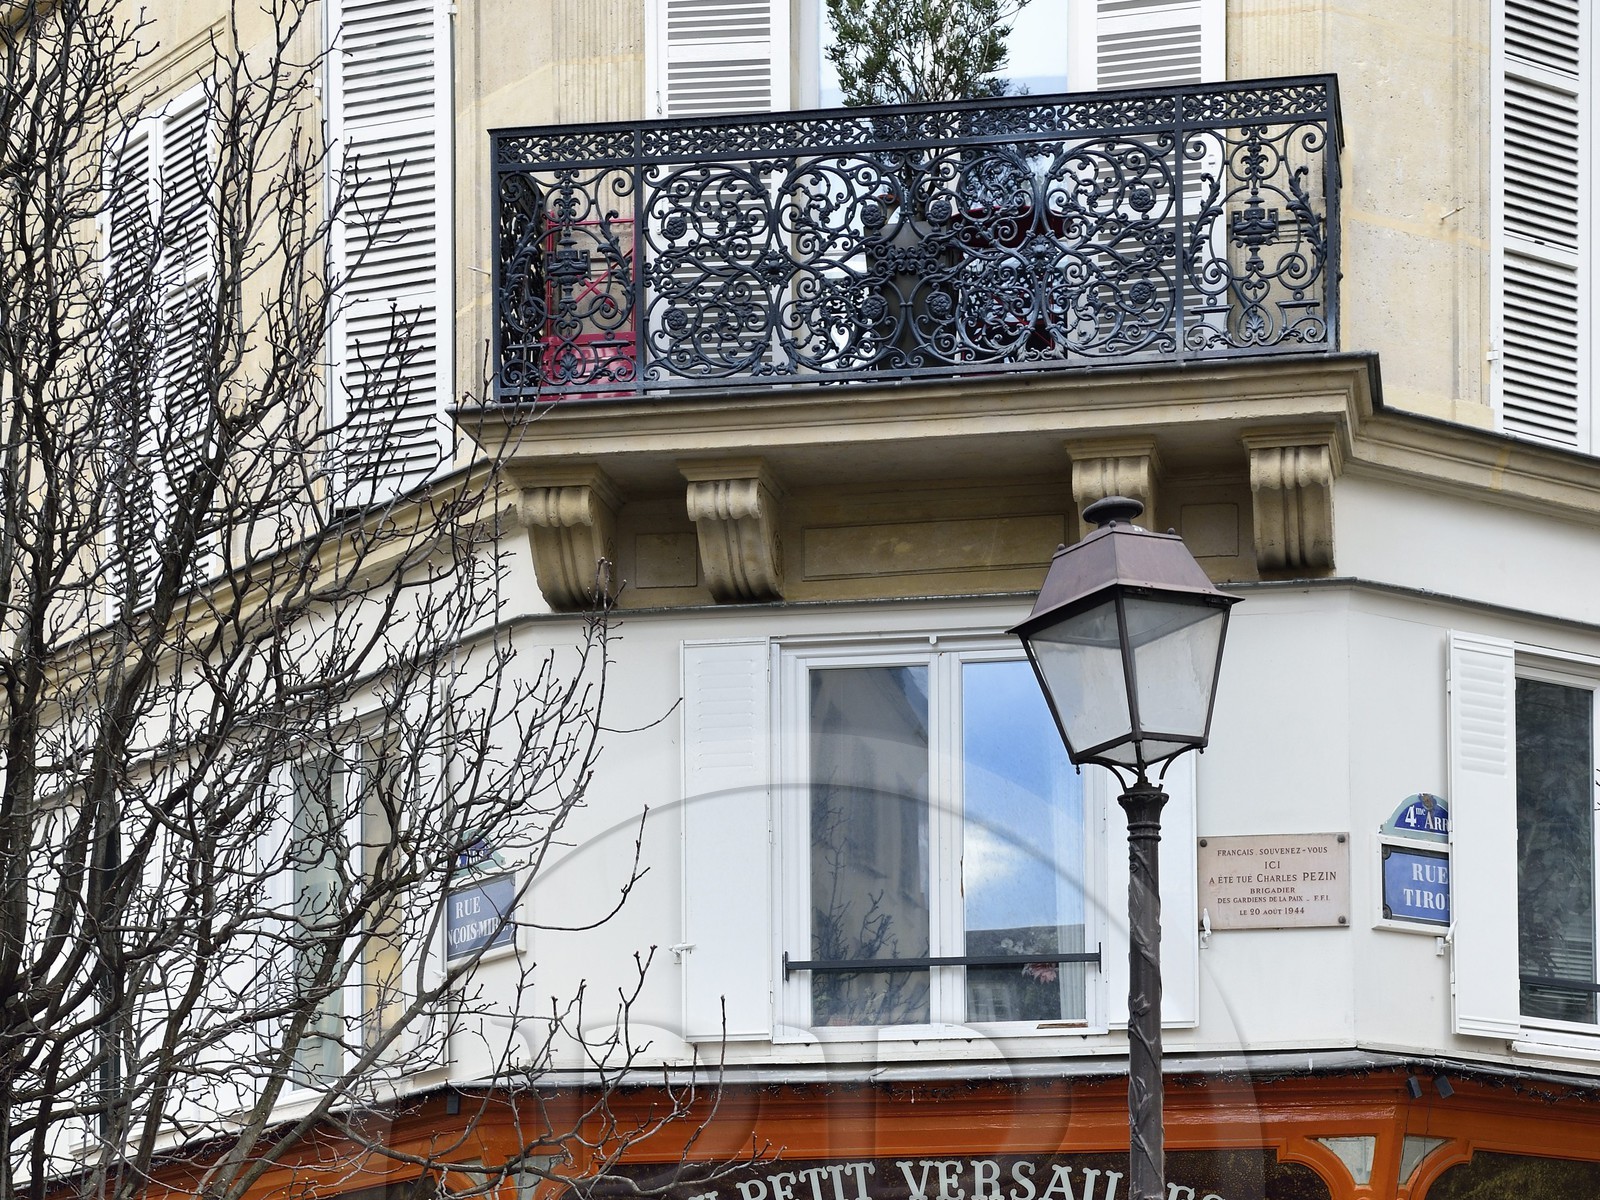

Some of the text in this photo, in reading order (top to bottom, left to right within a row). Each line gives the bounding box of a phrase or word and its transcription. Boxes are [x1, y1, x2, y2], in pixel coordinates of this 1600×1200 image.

[1264, 861, 1281, 870] ICI
[1209, 876, 1215, 884] A
[1302, 871, 1337, 882] PEZIN
[1412, 863, 1448, 885] RUE
[1250, 887, 1296, 895] BRIGADIER
[1403, 888, 1450, 911] TIRO
[456, 895, 481, 920] RUE
[1250, 908, 1261, 916] 20
[1284, 907, 1305, 916] 1944
